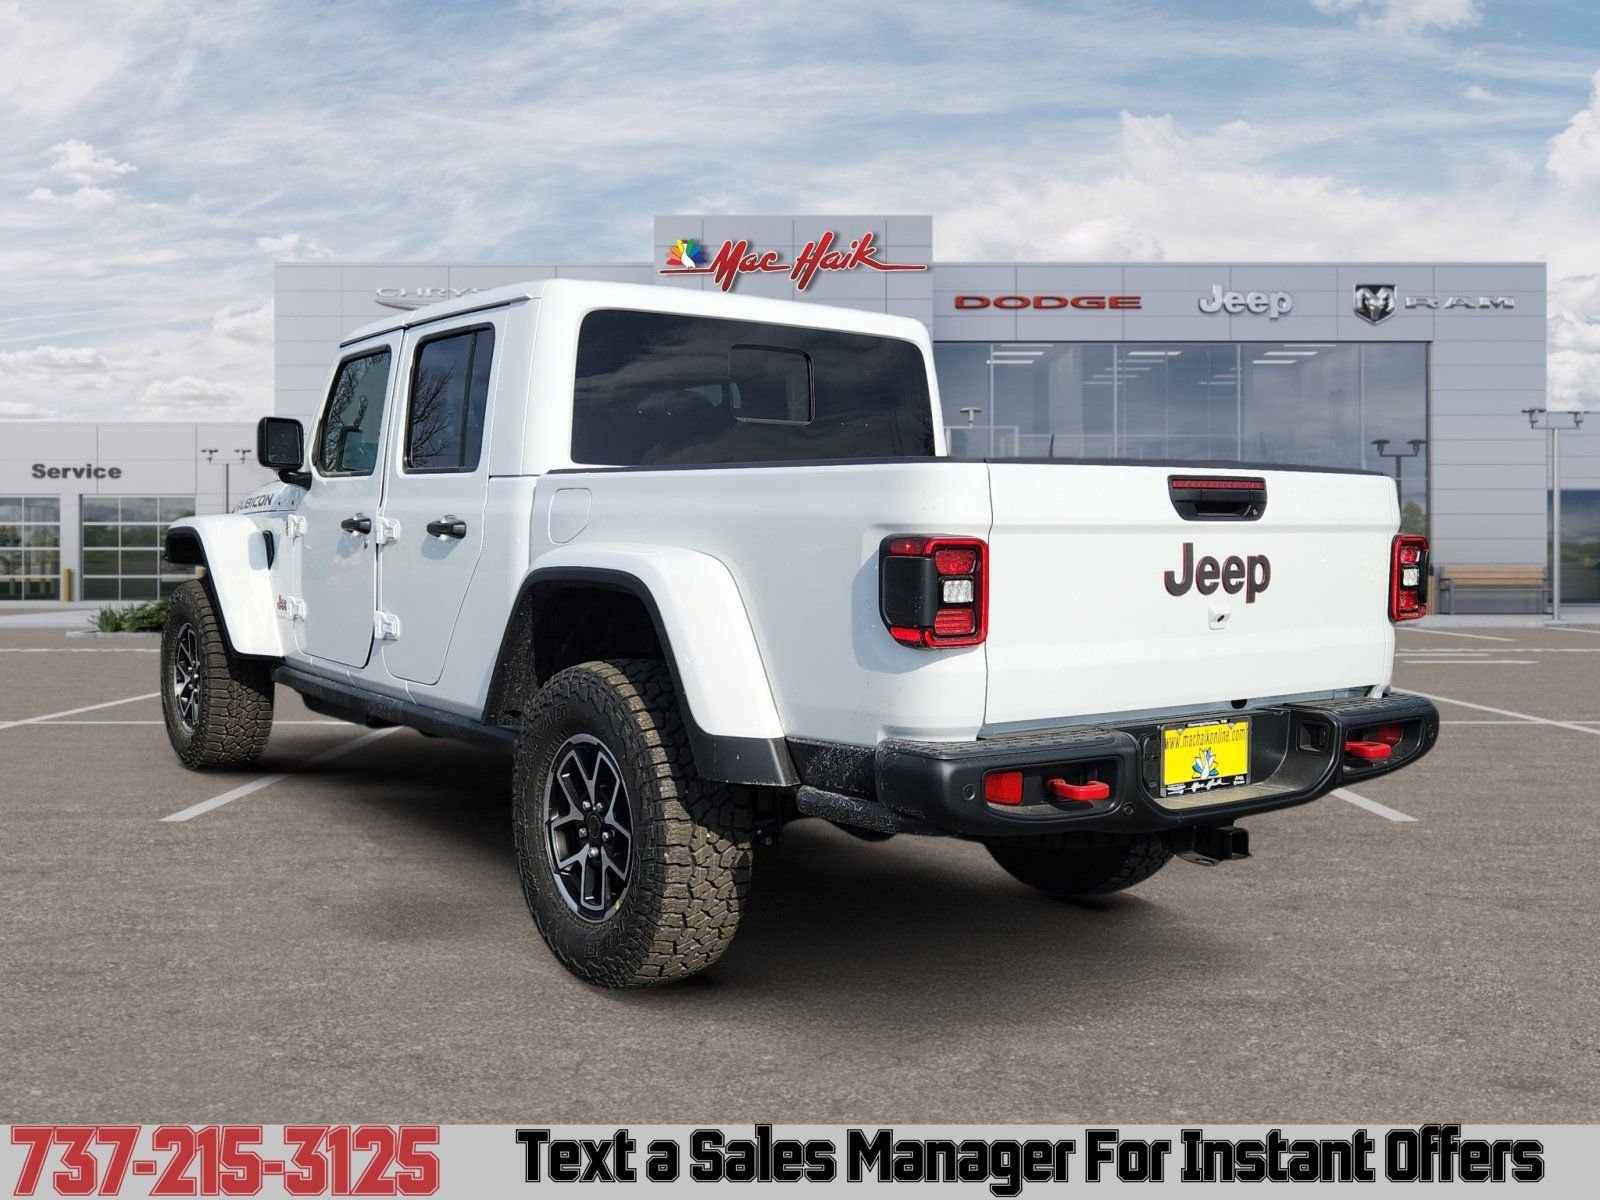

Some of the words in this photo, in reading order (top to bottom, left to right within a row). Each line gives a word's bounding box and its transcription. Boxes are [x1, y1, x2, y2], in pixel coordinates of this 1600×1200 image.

[659, 239, 791, 292] Mac
[789, 231, 927, 291] Haik
[955, 296, 1142, 309] DODGE
[1199, 284, 1292, 320] Jeep
[1405, 296, 1514, 309] RAM
[31, 463, 122, 479] Service
[1164, 542, 1271, 604] Jeep
[1164, 727, 1246, 750] www.machaikonline.com
